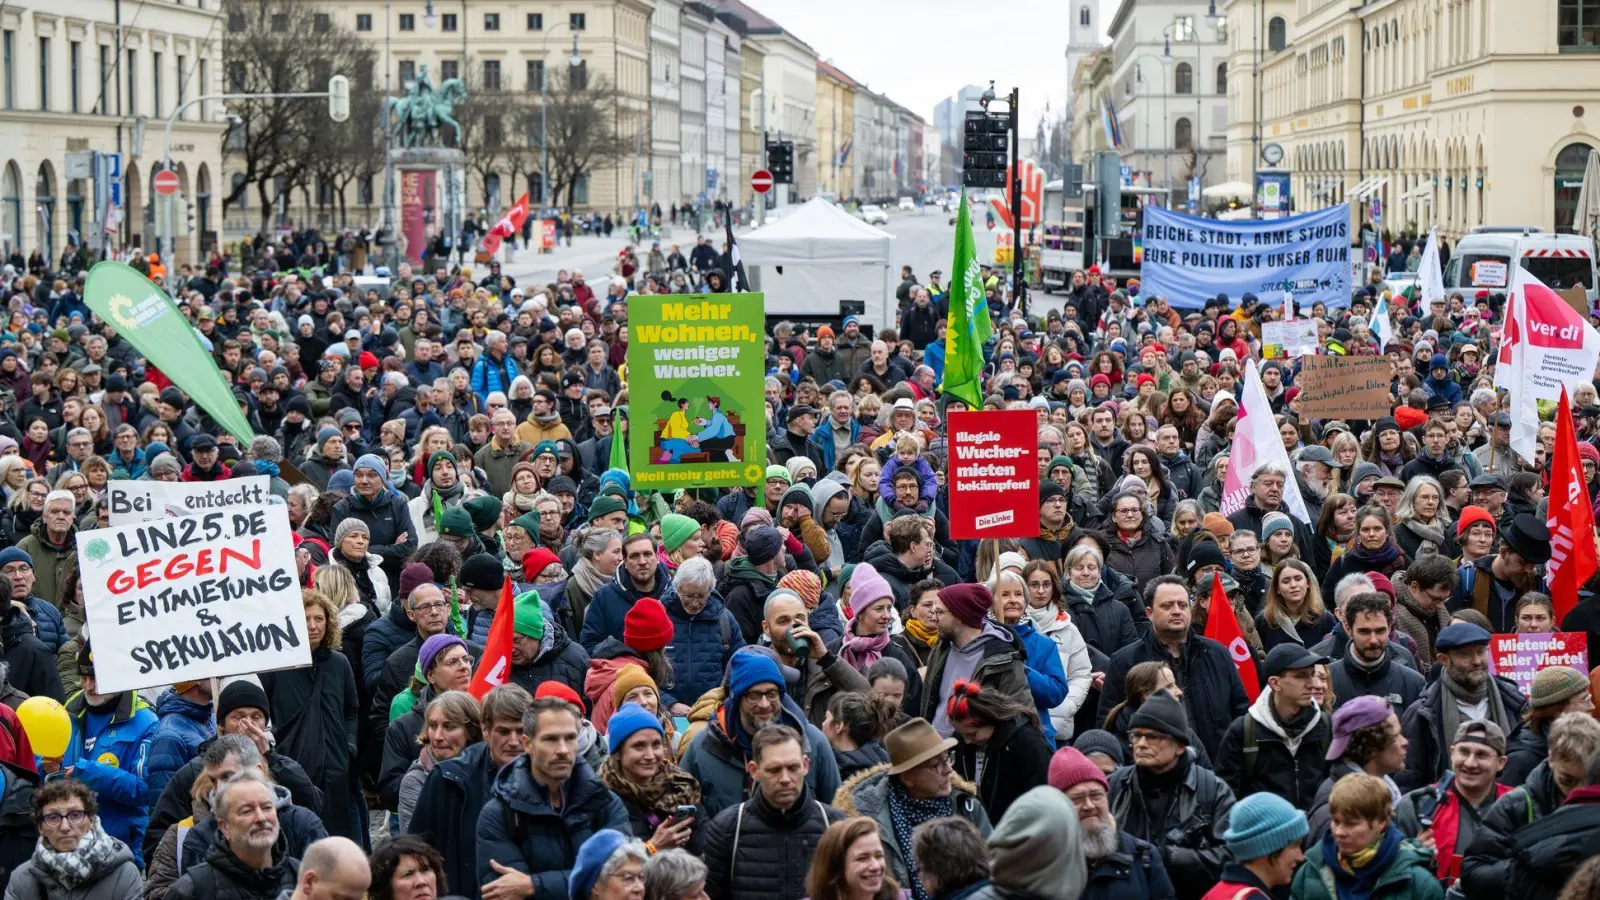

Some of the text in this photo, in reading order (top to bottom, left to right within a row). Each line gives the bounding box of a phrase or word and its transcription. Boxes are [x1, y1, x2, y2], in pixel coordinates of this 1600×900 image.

[1146, 224, 1193, 243] REICHE
[1254, 229, 1293, 245] ARME
[1299, 222, 1347, 242] STUDIS
[1143, 247, 1348, 269] EURE POLITIK IST UNSER RUIN
[661, 301, 732, 321] Mehr
[636, 323, 757, 343] Wohnen,
[1529, 319, 1579, 341] ver.di
[653, 345, 740, 362] weniger
[1544, 353, 1567, 362] Vereinte
[653, 363, 741, 379] Wucher.
[1541, 365, 1579, 376] gewerkschaft
[956, 431, 1001, 444] Illegale
[956, 445, 1029, 459] Wucher-
[667, 469, 702, 481] mehr
[704, 468, 740, 481] geht.
[956, 463, 1015, 477] mieten
[957, 480, 1030, 492] bekämpfen!
[111, 490, 152, 514] Bei
[978, 514, 1011, 527] Die Linke
[117, 510, 267, 558] LIN25.DE
[106, 539, 262, 595] GEGEN
[117, 568, 292, 625] ENTMIETUNG
[196, 608, 222, 627] &
[130, 615, 300, 675] SPEKULATION
[1498, 637, 1566, 652] Mietende
[1499, 652, 1584, 666] aller Viertel
